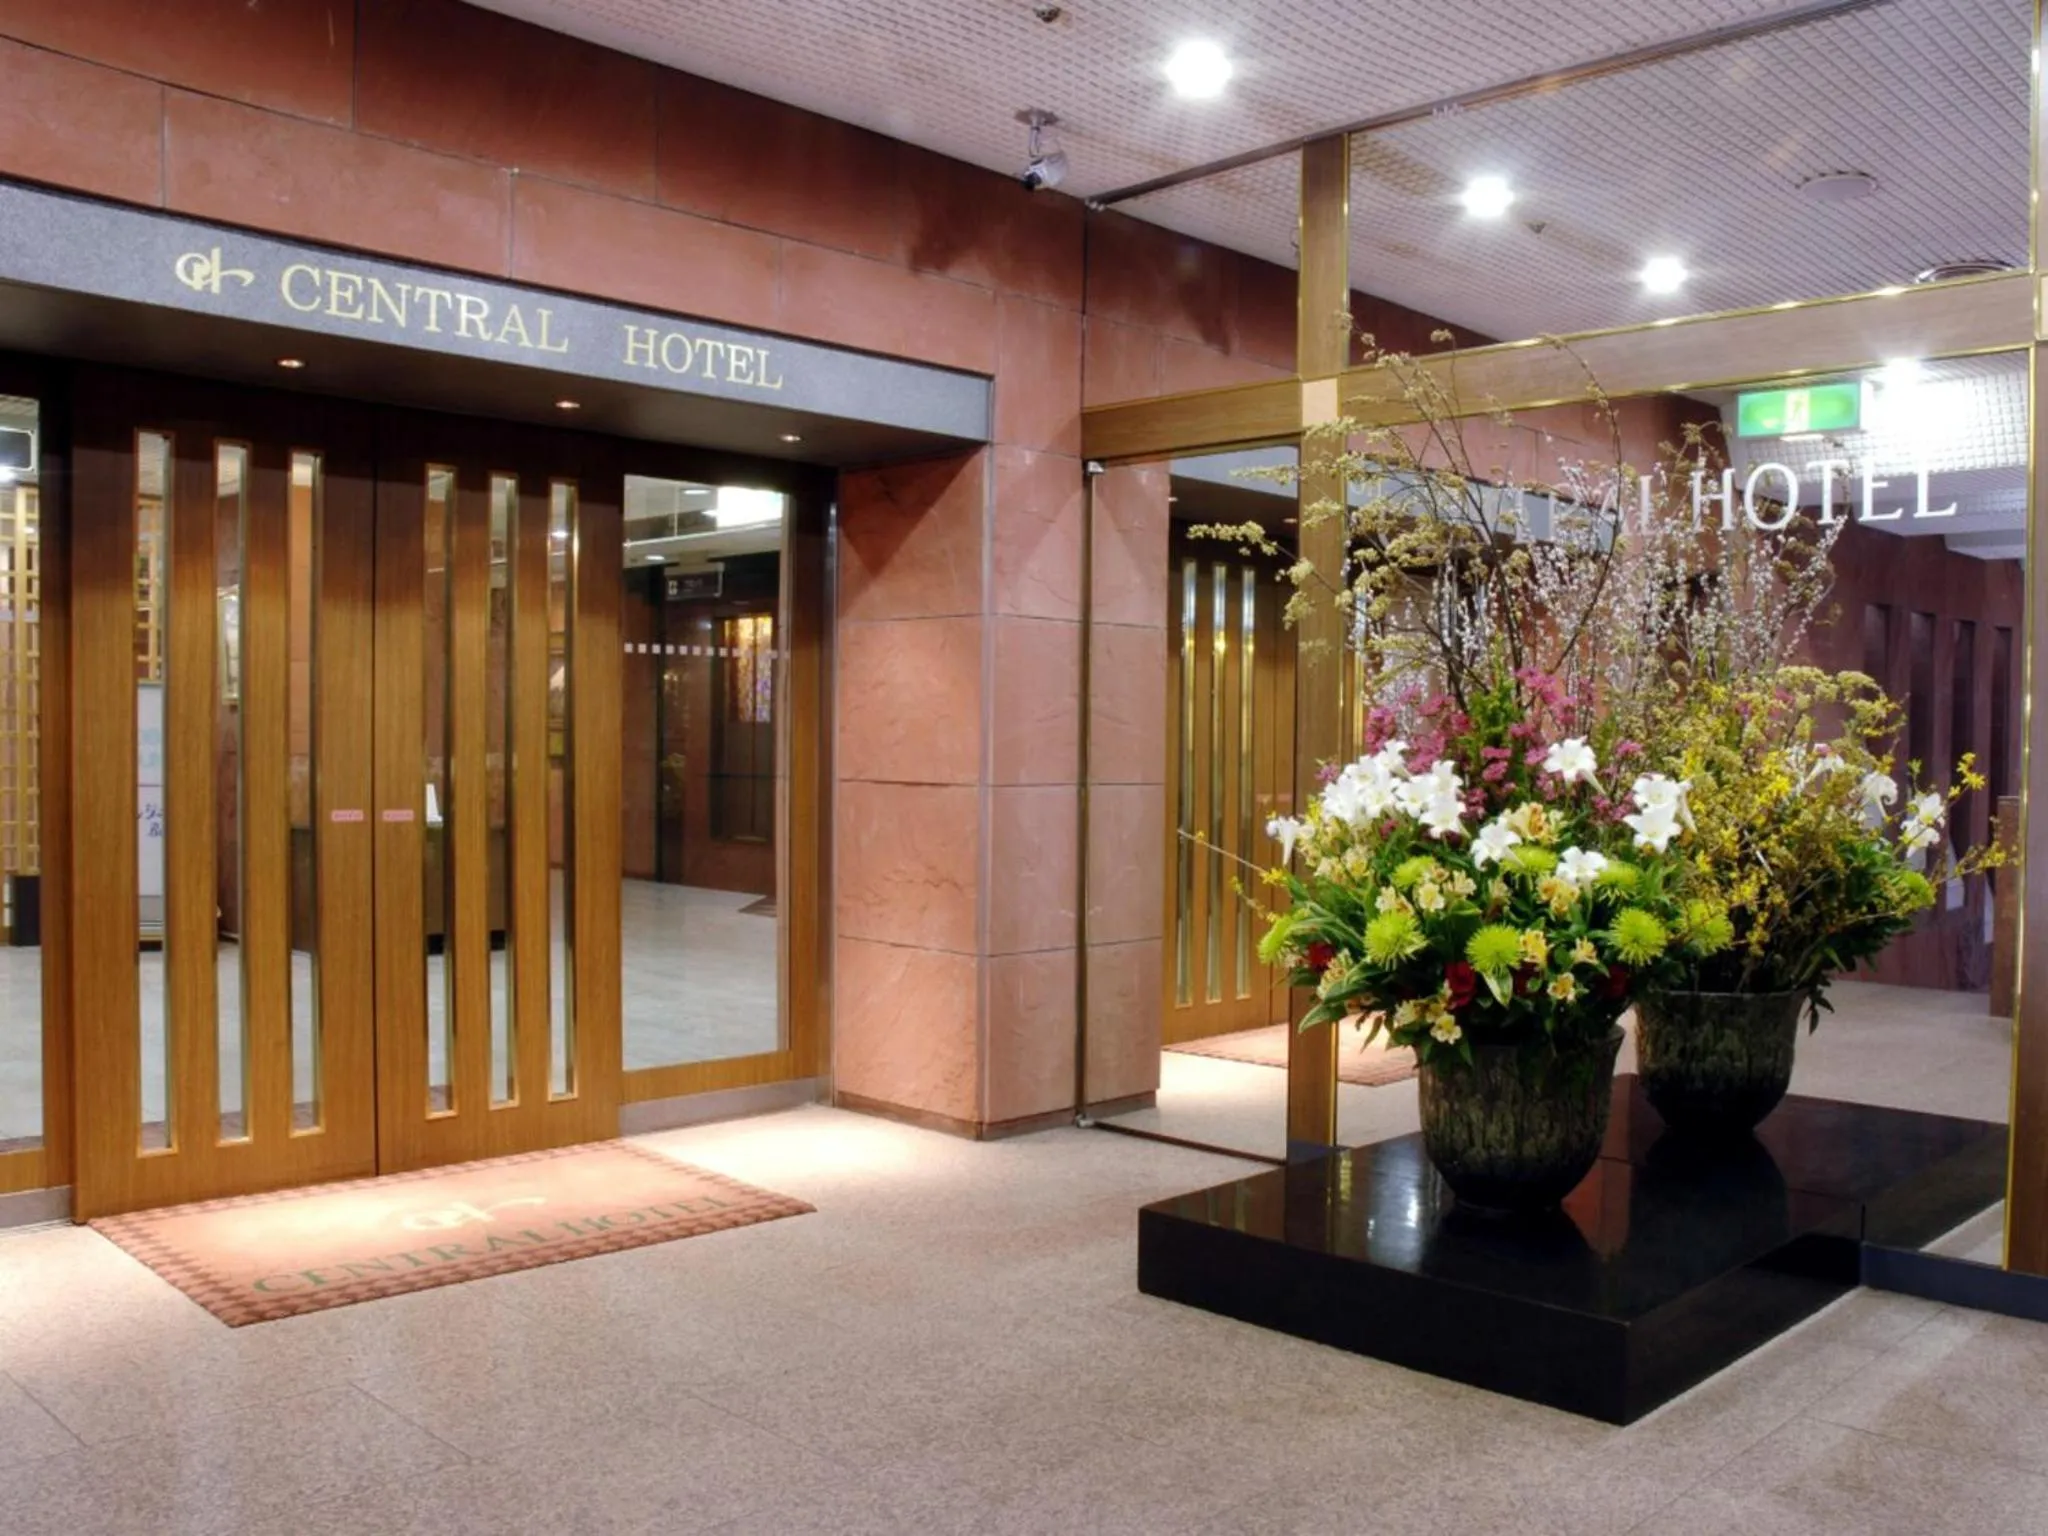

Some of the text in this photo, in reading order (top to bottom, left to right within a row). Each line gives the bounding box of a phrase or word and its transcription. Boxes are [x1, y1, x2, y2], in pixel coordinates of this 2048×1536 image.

[280, 264, 569, 353] CENTRAL
[623, 324, 784, 390] HOTEL
[1690, 458, 1958, 532] HOTEL
[252, 1227, 562, 1294] CENTRAL
